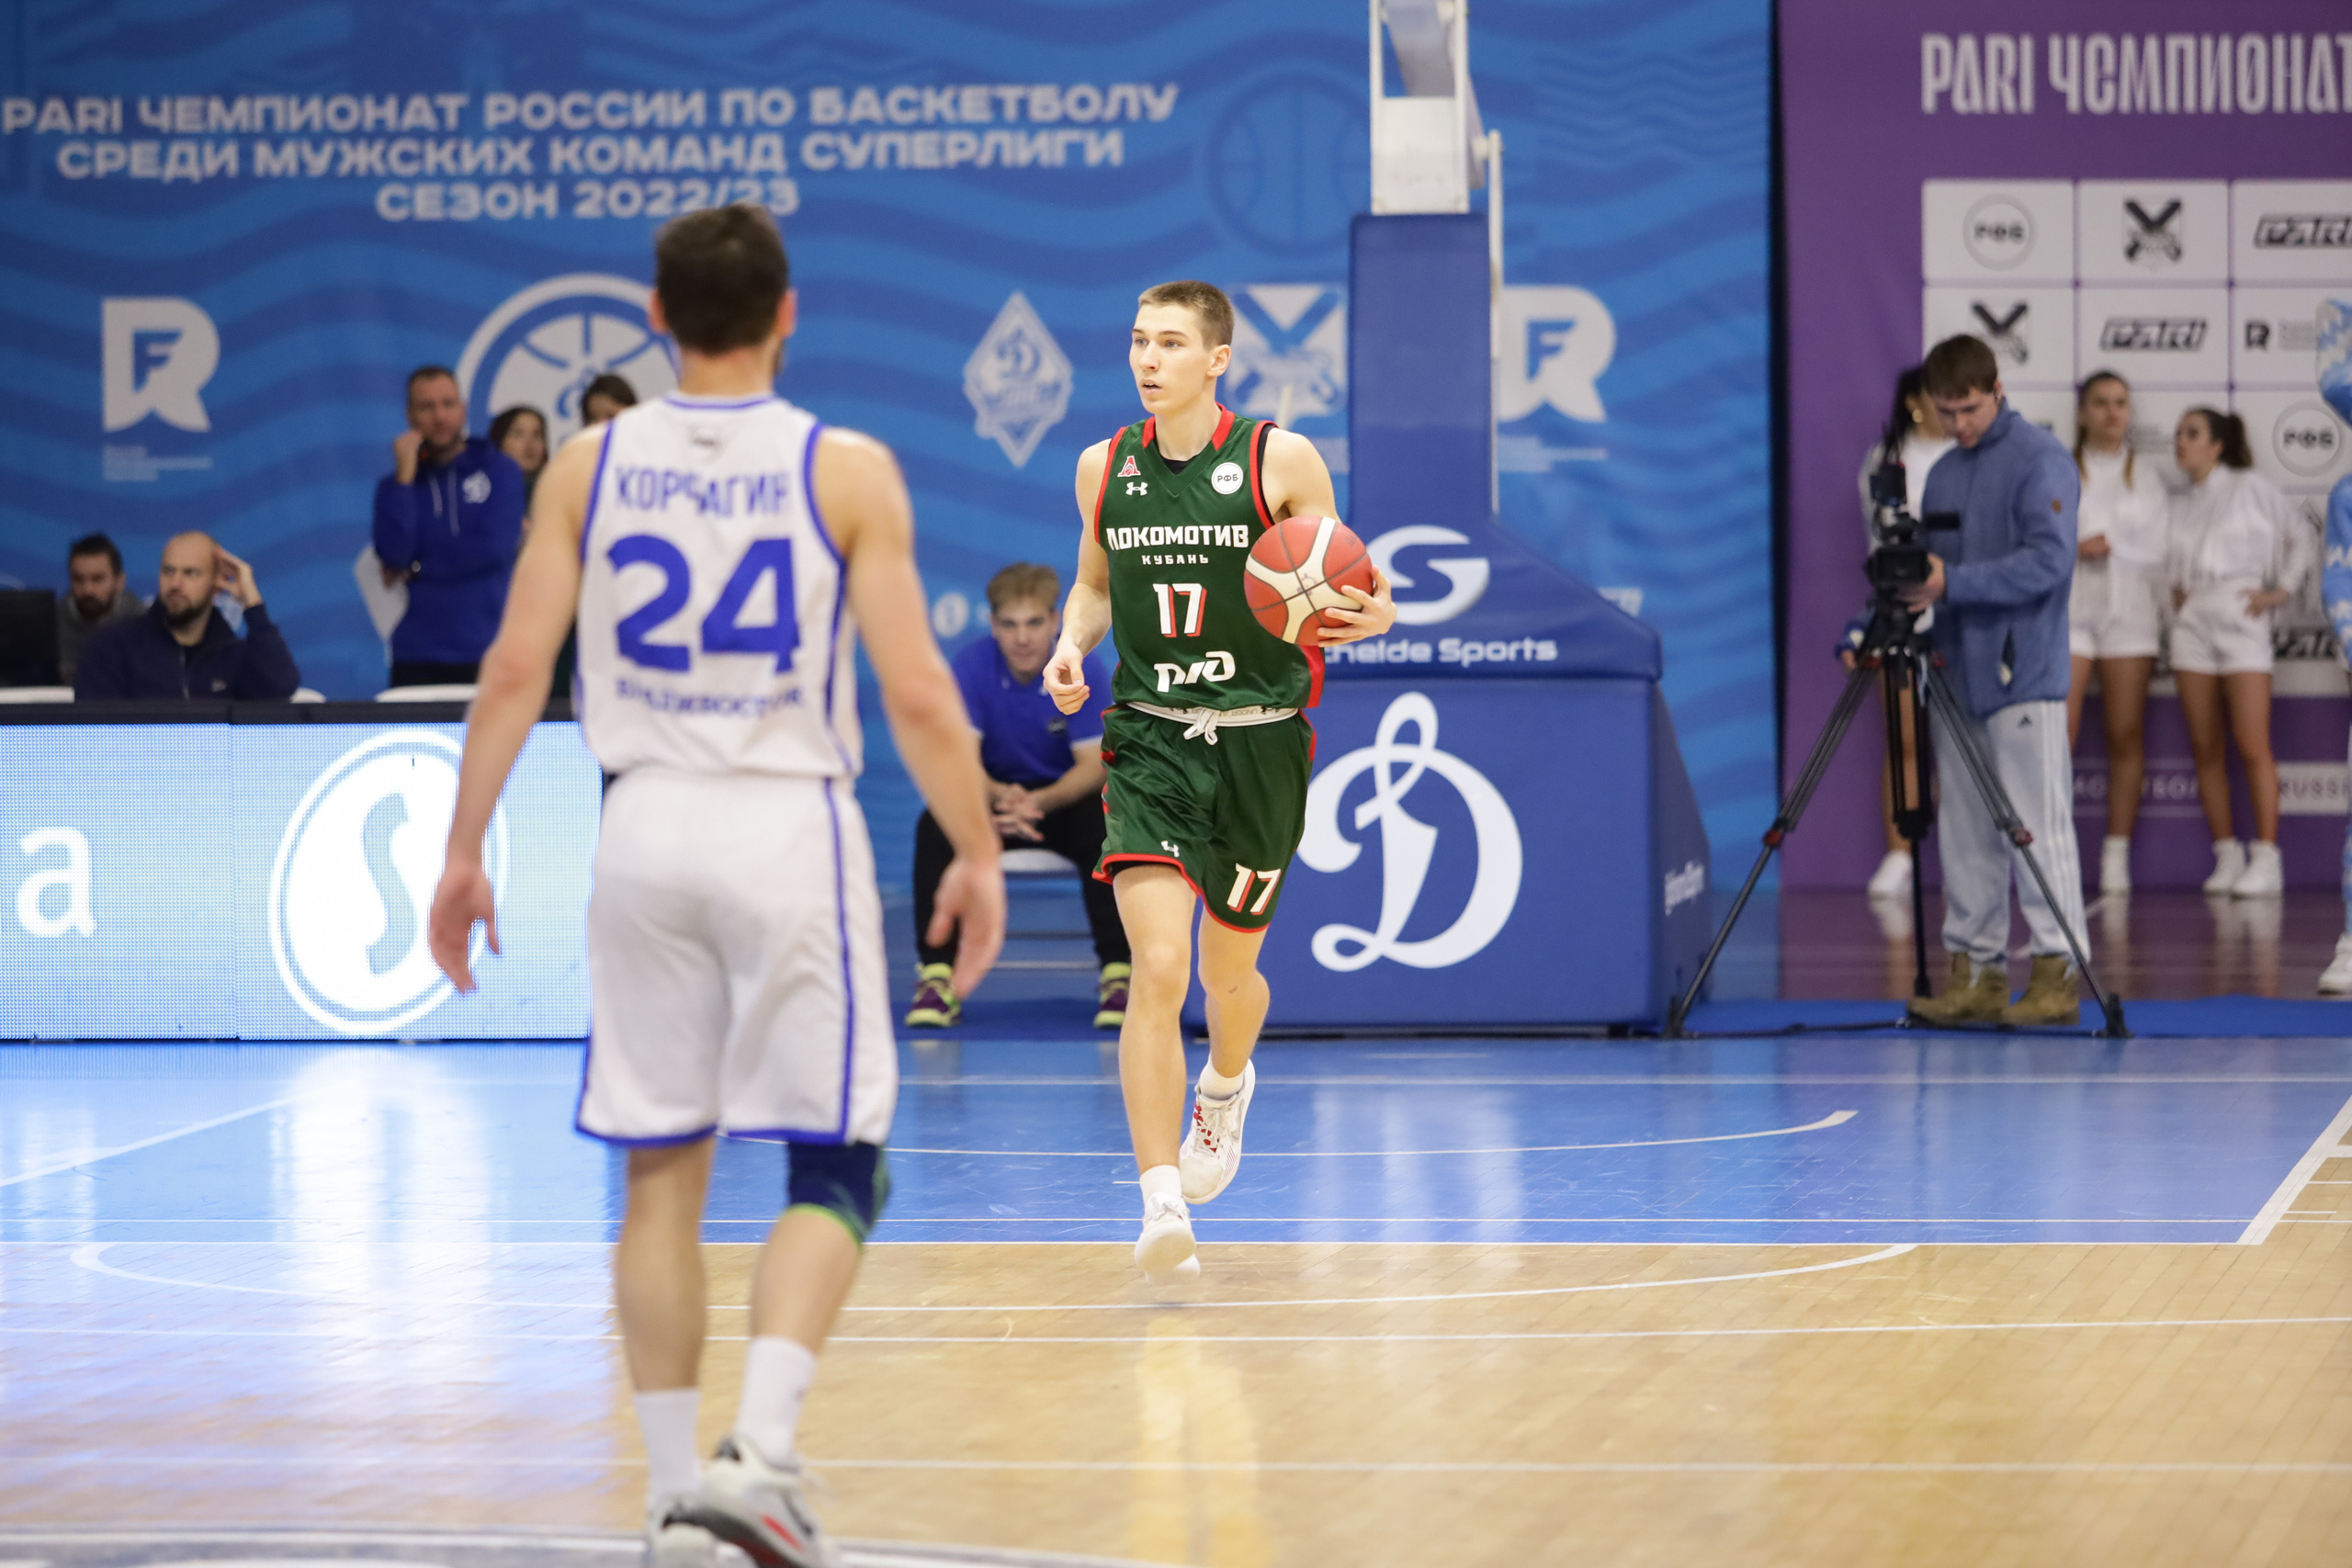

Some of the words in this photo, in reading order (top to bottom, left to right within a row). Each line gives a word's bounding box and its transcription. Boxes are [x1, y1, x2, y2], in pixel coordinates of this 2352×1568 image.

[1920, 33, 2035, 115] PARI
[2, 97, 124, 133] PARI
[138, 93, 469, 133] ЧЕМПИОНАТ
[483, 89, 707, 131] РОССИИ
[719, 87, 796, 126] ПО
[809, 83, 1179, 125] БАСКЕТБОЛУ
[55, 141, 240, 183] СРЕДИ
[254, 137, 534, 177] МУЖСКИХ
[549, 134, 788, 175] КОМАНД
[800, 130, 1125, 171] СУПЕРЛИГИ
[375, 181, 560, 221] СЕЗОН
[573, 178, 800, 220] 2022/23
[1216, 473, 1238, 483] РФБ
[1106, 525, 1250, 551] ЛОКОМОТИВ
[1141, 554, 1209, 565] КУБАНЬ
[605, 533, 802, 675] 24
[1152, 583, 1207, 637] 17
[1438, 637, 1559, 668] Sports
[1227, 863, 1281, 916] 17
